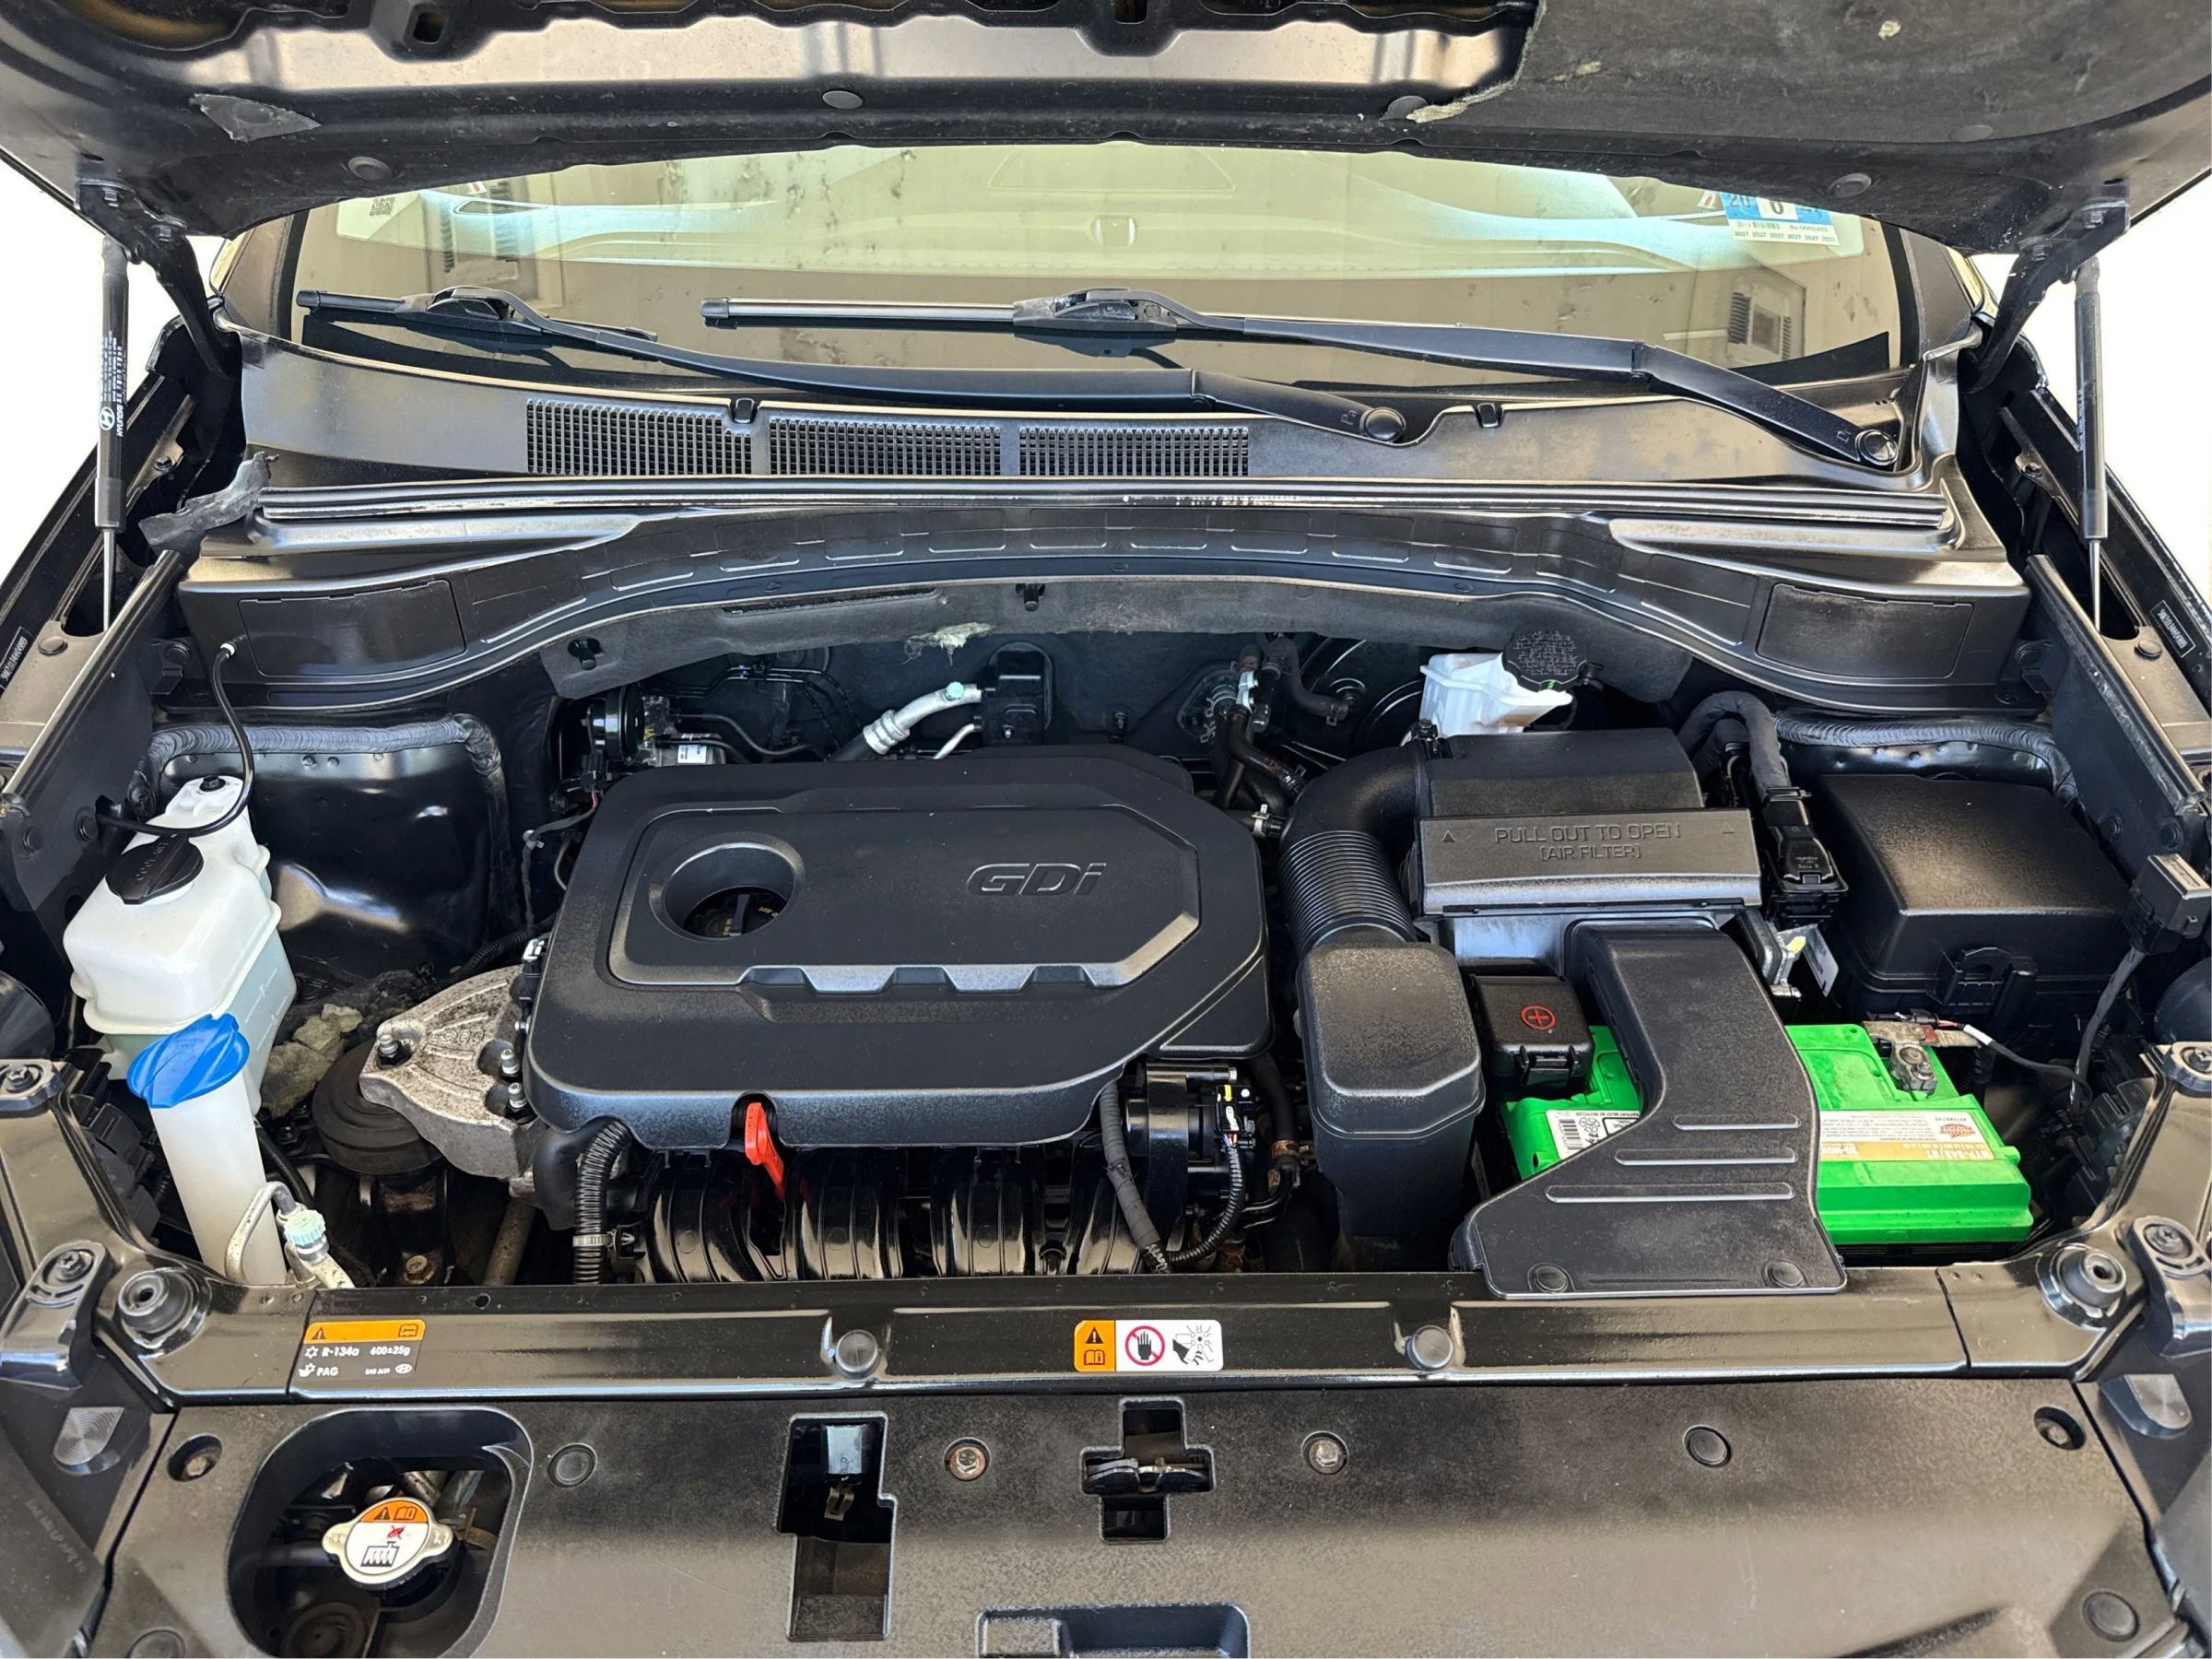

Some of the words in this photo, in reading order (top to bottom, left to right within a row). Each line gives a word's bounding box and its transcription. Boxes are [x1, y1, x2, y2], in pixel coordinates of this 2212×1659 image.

[116, 404, 124, 437] HYUNDAI
[1494, 826, 1547, 844] PULL
[1550, 824, 1590, 841] OUT
[1594, 823, 1622, 841] TO
[1627, 821, 1682, 840] OPEN
[966, 862, 1106, 896] GDi
[321, 1347, 360, 1357] R-134a
[370, 1346, 411, 1357] 600±25g
[316, 1367, 339, 1376] PAG
